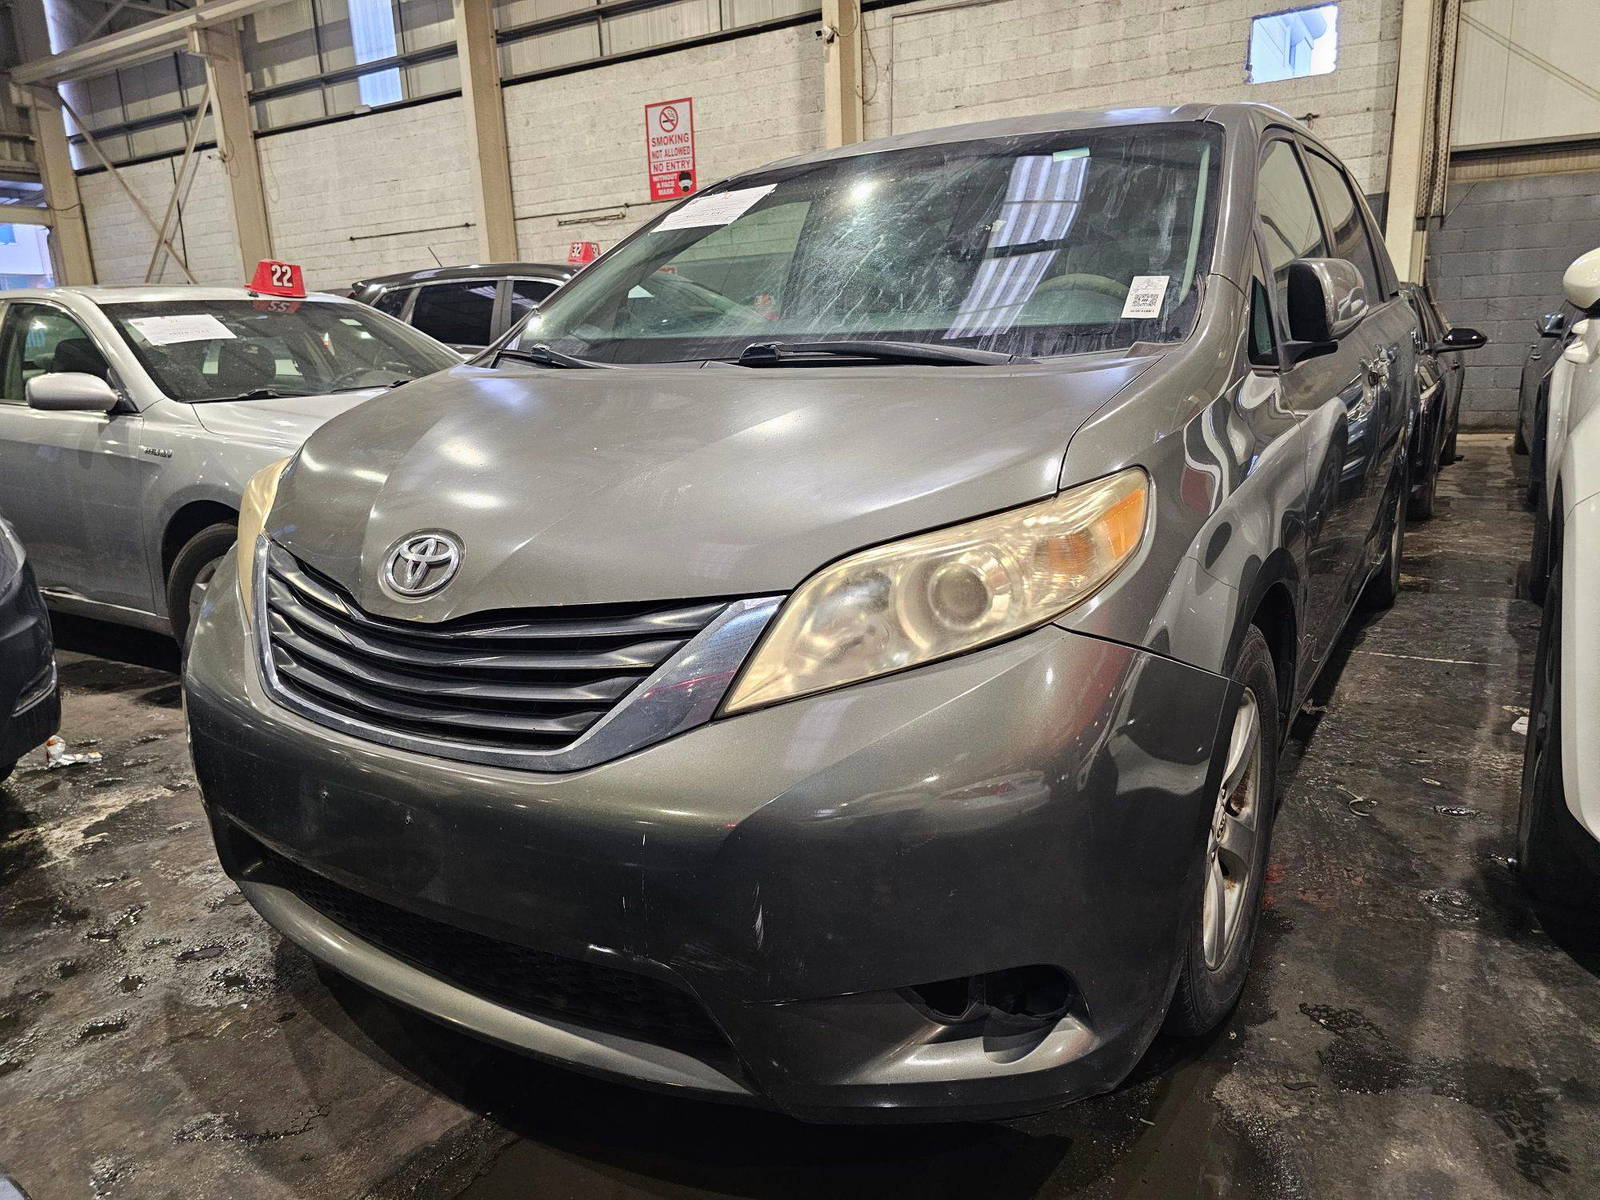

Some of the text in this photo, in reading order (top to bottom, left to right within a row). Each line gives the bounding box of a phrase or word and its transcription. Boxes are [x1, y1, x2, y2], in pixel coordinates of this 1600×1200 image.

[652, 133, 689, 147] SMOKING
[652, 146, 690, 159] NOT ALLOWED
[653, 160, 690, 172] NO ENTRY
[571, 242, 582, 257] 32
[271, 264, 293, 287] 22
